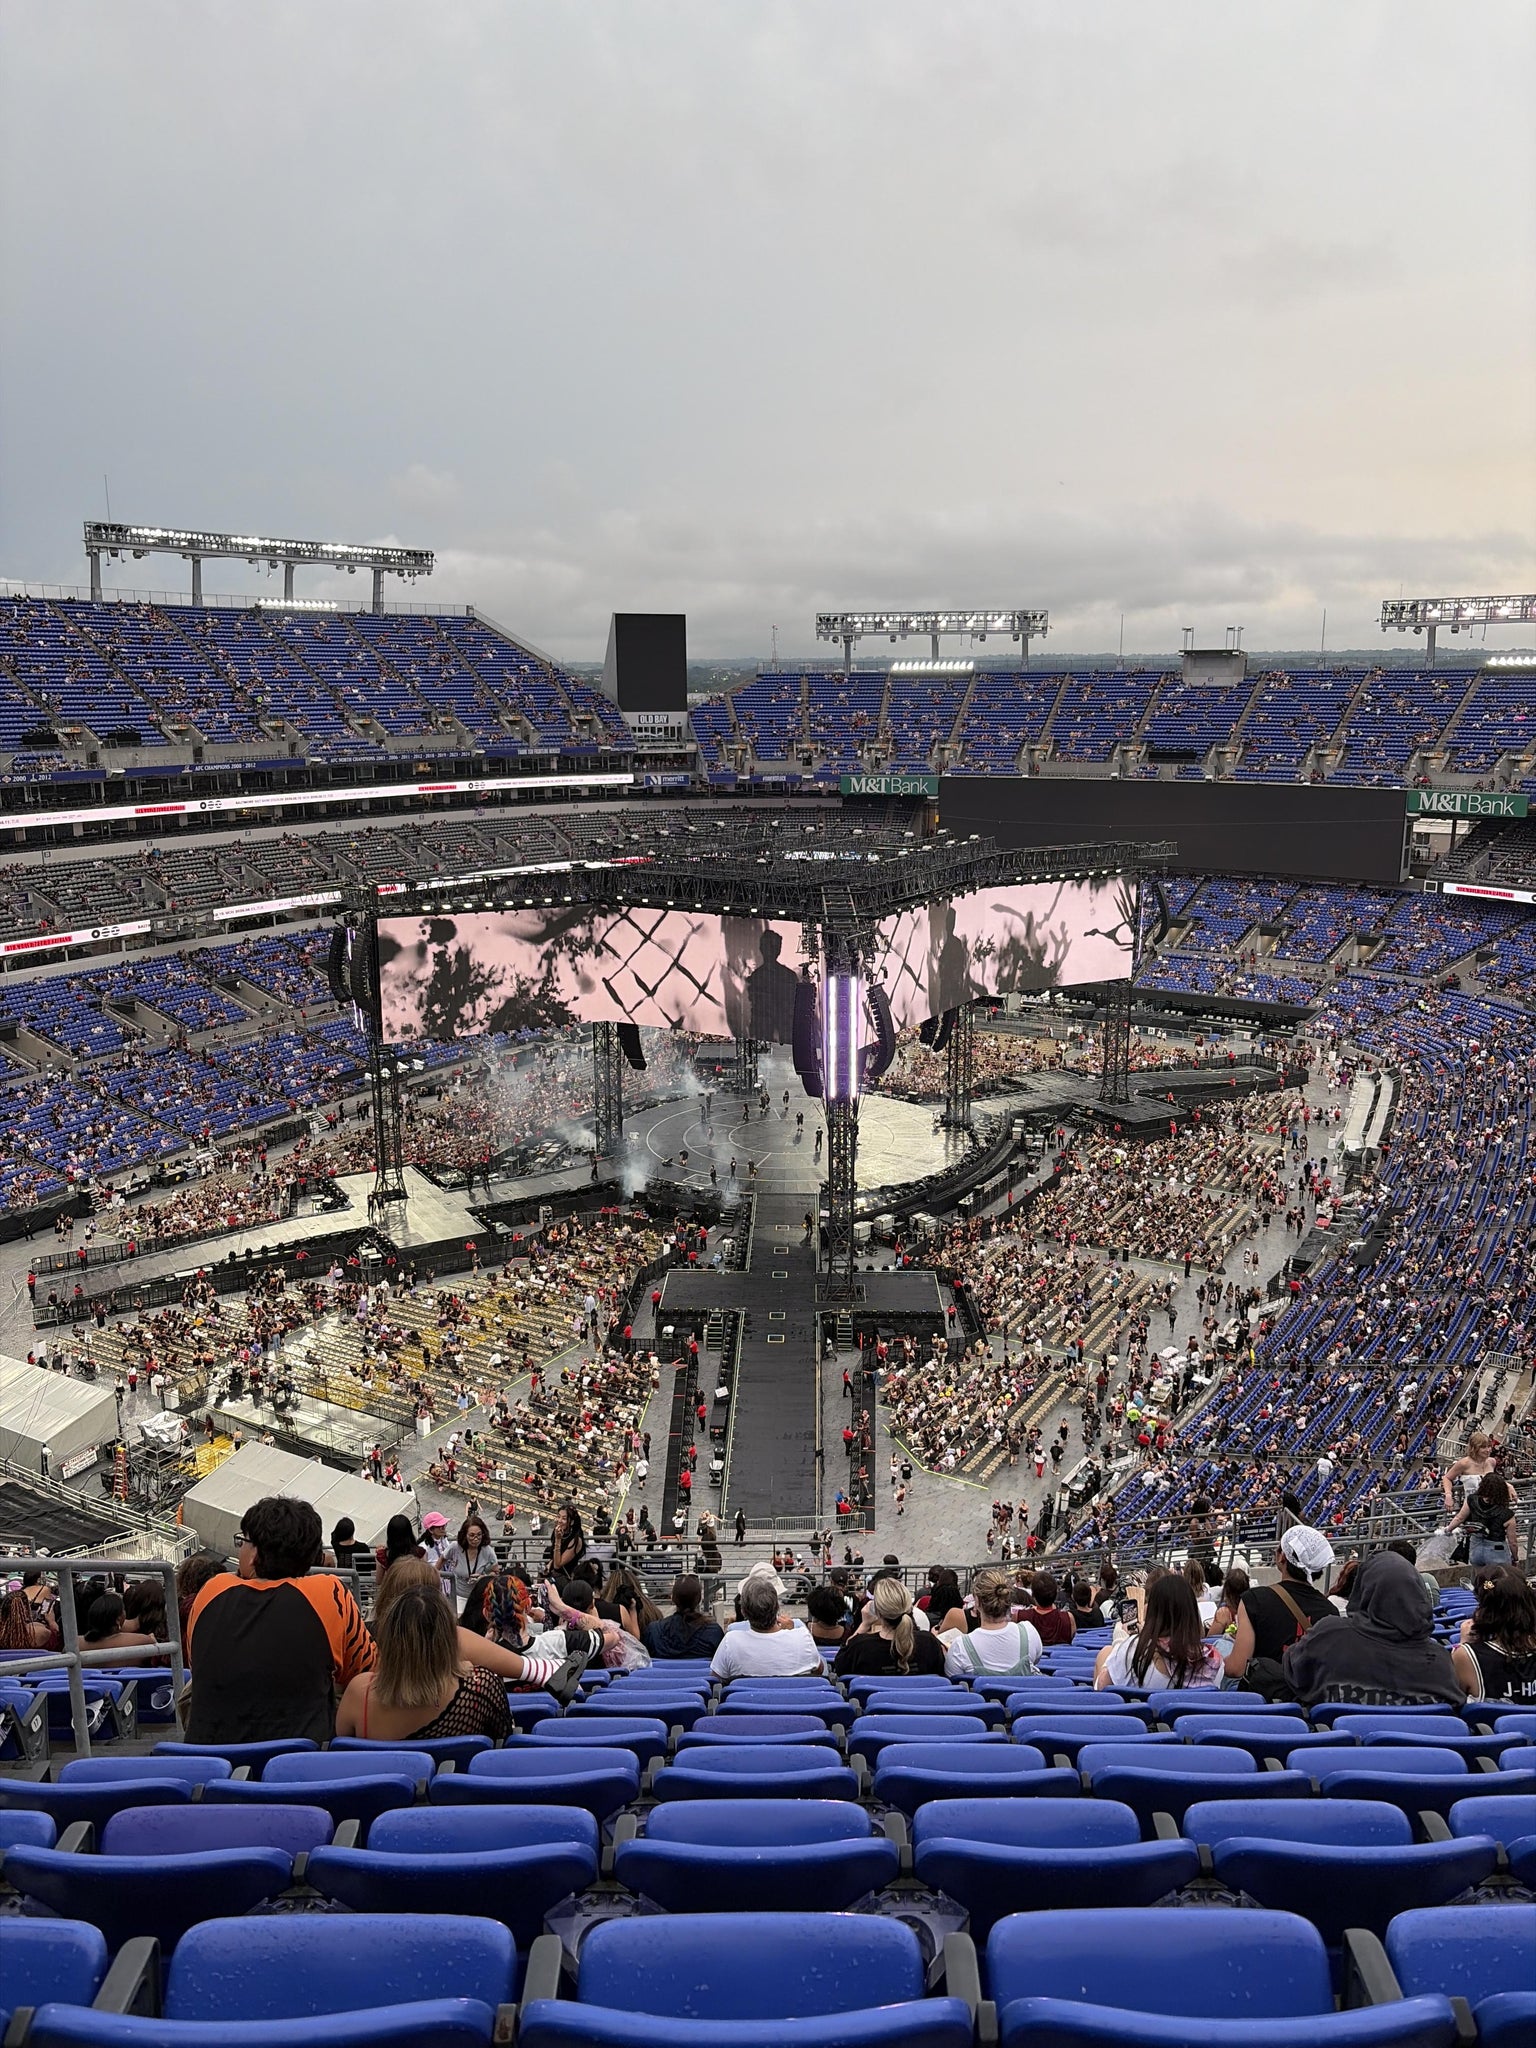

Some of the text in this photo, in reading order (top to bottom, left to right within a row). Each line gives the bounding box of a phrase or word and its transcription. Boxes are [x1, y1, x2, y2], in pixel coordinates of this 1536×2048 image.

[640, 715, 668, 724] OLD BAY
[662, 775, 685, 783] merritt
[850, 777, 929, 794] M&T Bank
[1418, 792, 1514, 816] M&T Bank
